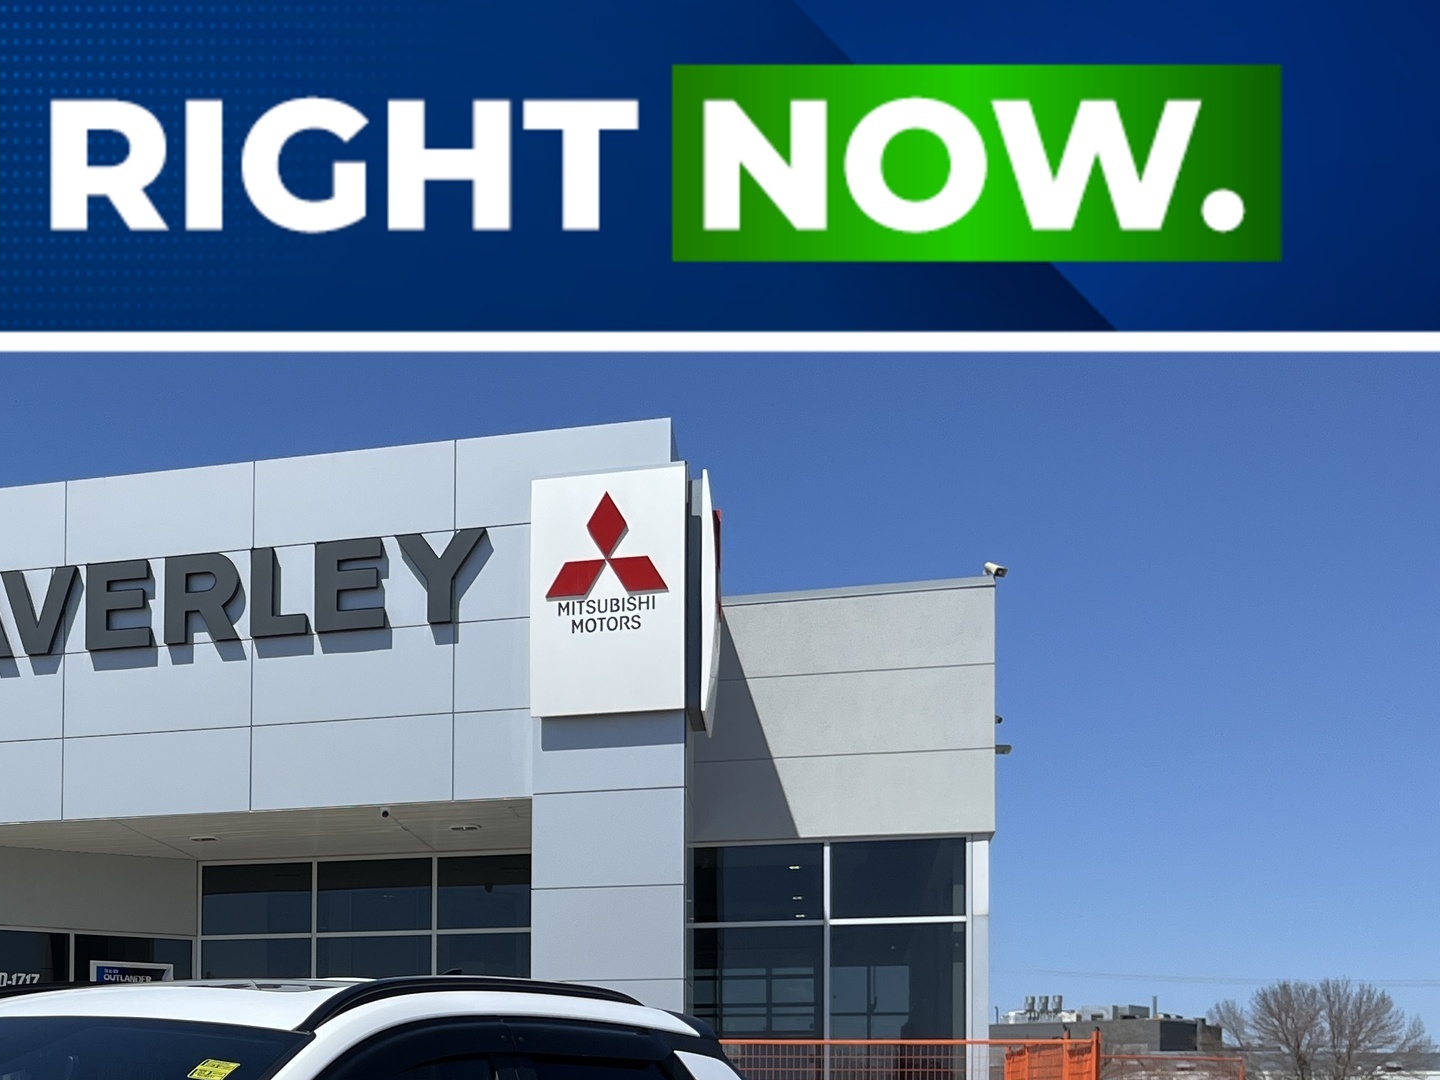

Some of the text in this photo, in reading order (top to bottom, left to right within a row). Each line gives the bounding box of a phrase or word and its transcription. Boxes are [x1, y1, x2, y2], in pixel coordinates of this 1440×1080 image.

[557, 595, 656, 616] MITSUBISHI
[571, 614, 642, 634] MOTORS
[103, 974, 152, 983] OUTLANDER
